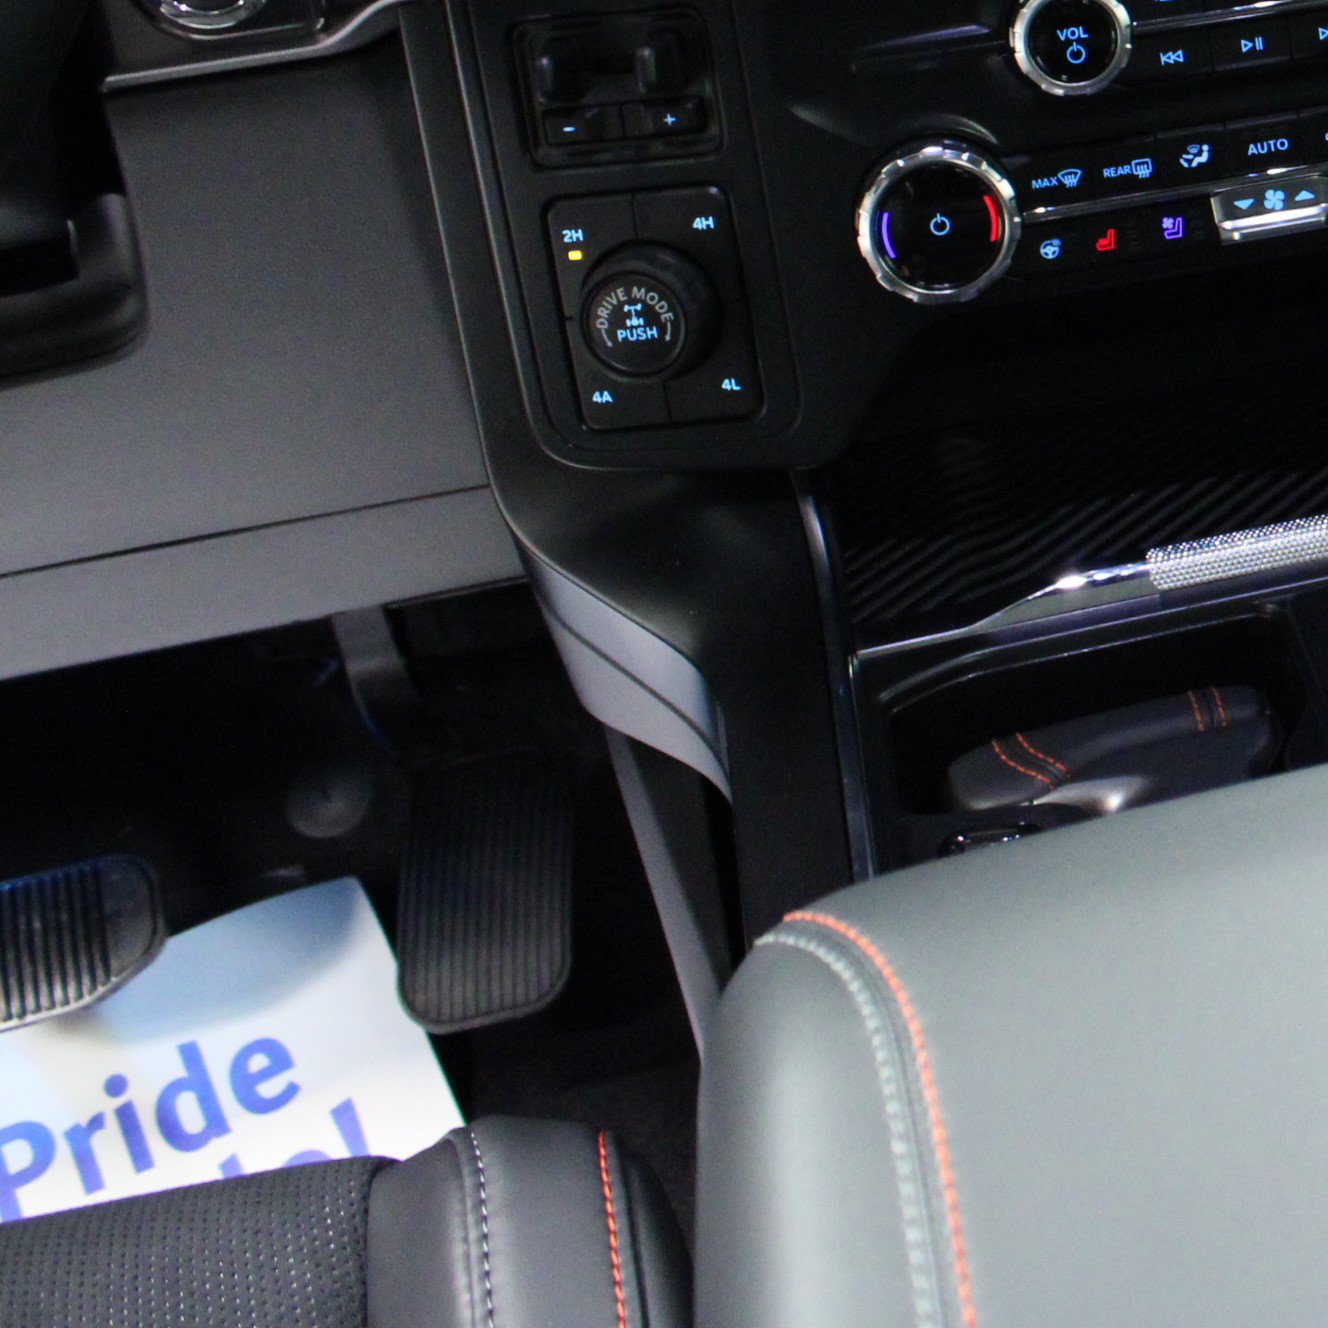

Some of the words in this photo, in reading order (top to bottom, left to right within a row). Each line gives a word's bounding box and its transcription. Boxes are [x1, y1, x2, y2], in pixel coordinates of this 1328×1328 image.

[1056, 26, 1089, 42] VOL
[1247, 138, 1290, 156] AUTO
[1103, 165, 1132, 179] REAR
[1031, 176, 1059, 190] MAX
[692, 216, 715, 230] 4H
[562, 228, 584, 243] 2H
[596, 287, 628, 330] DRIVE
[631, 286, 675, 324] MODE
[616, 326, 658, 342] PUSH
[721, 378, 742, 391] 4L
[592, 390, 614, 404] 4A
[0, 1036, 301, 1222] Pride
